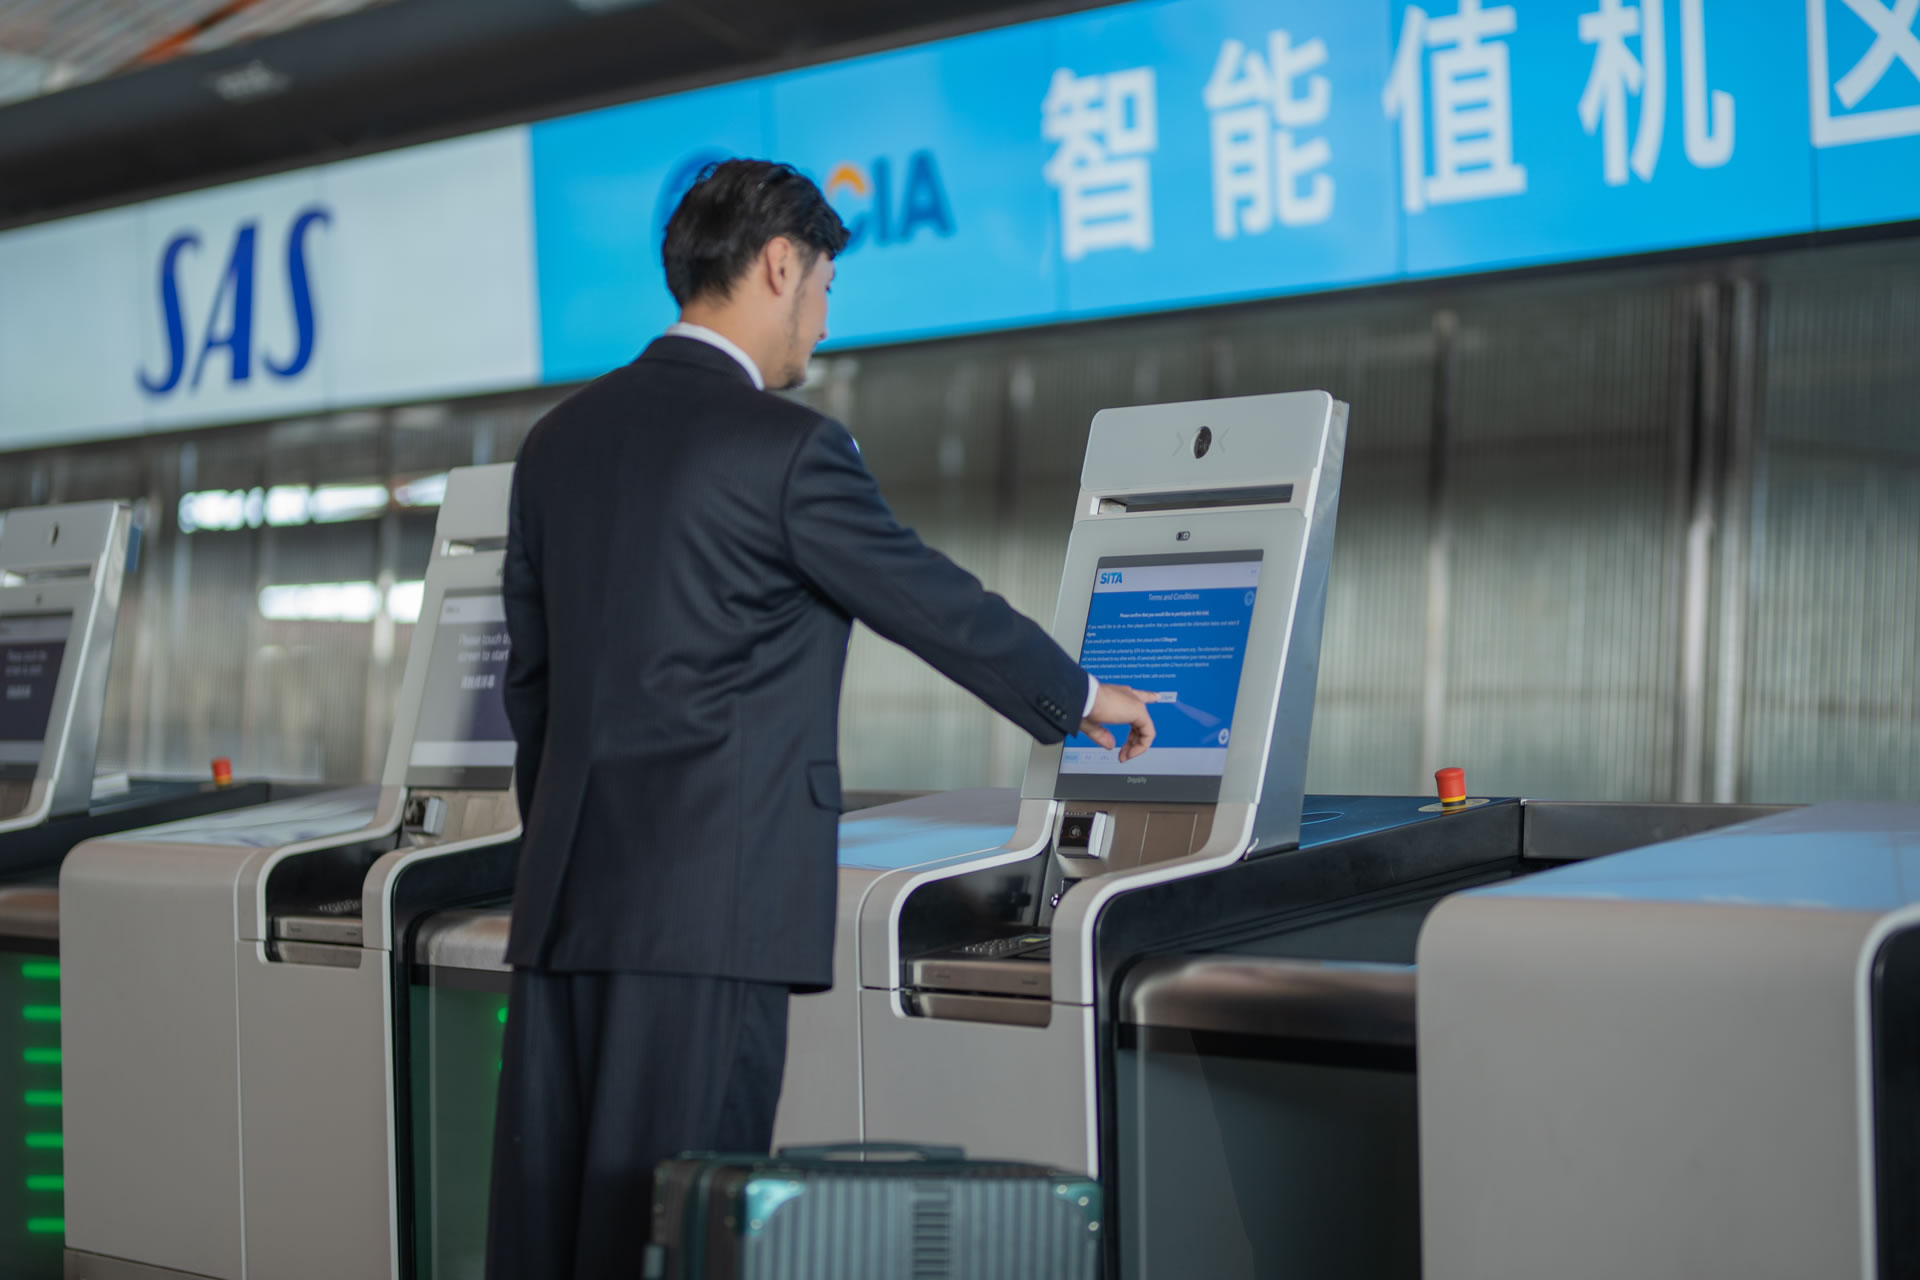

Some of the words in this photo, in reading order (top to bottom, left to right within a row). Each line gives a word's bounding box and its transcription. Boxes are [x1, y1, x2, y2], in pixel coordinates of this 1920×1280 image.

[137, 204, 331, 400] SAS
[1100, 571, 1123, 585] SITA
[1148, 593, 1163, 601] Terms
[1163, 592, 1173, 601] and
[1173, 591, 1200, 601] Conditions
